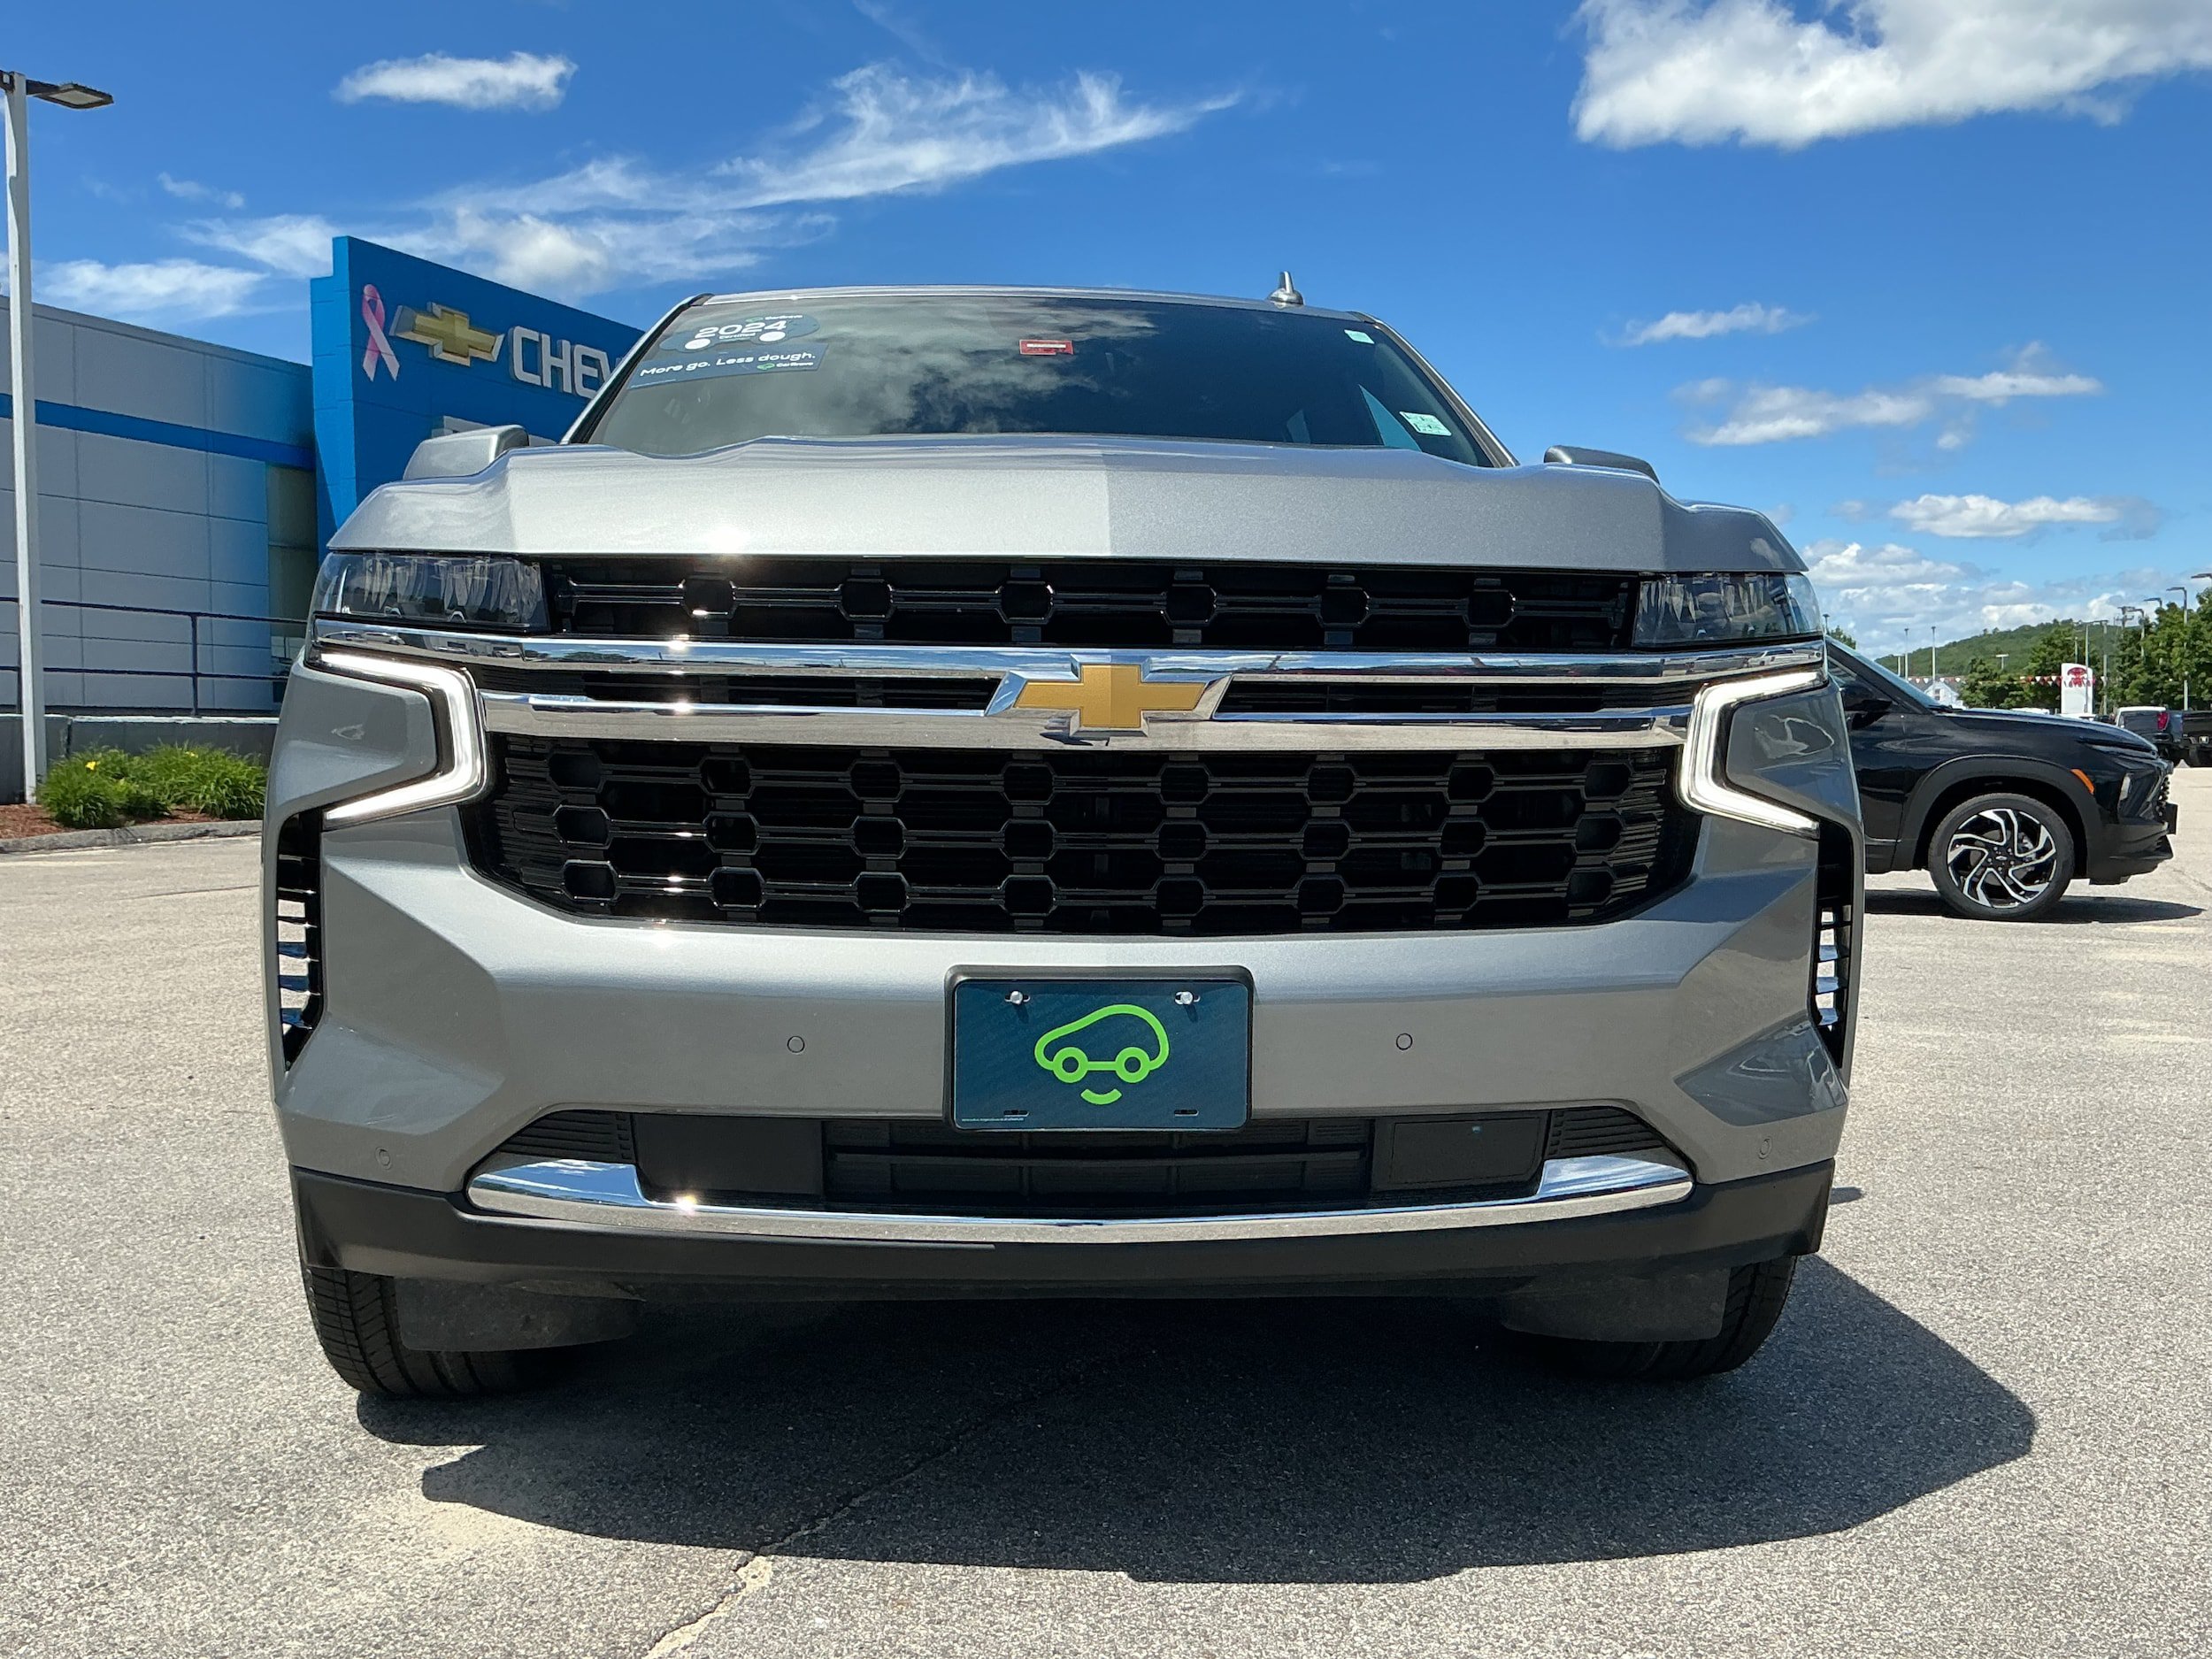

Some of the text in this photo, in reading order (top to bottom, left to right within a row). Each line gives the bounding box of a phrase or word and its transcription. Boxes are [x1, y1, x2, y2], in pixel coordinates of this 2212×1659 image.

[694, 320, 787, 339] 2024
[640, 351, 816, 377] More go. Less dough.
